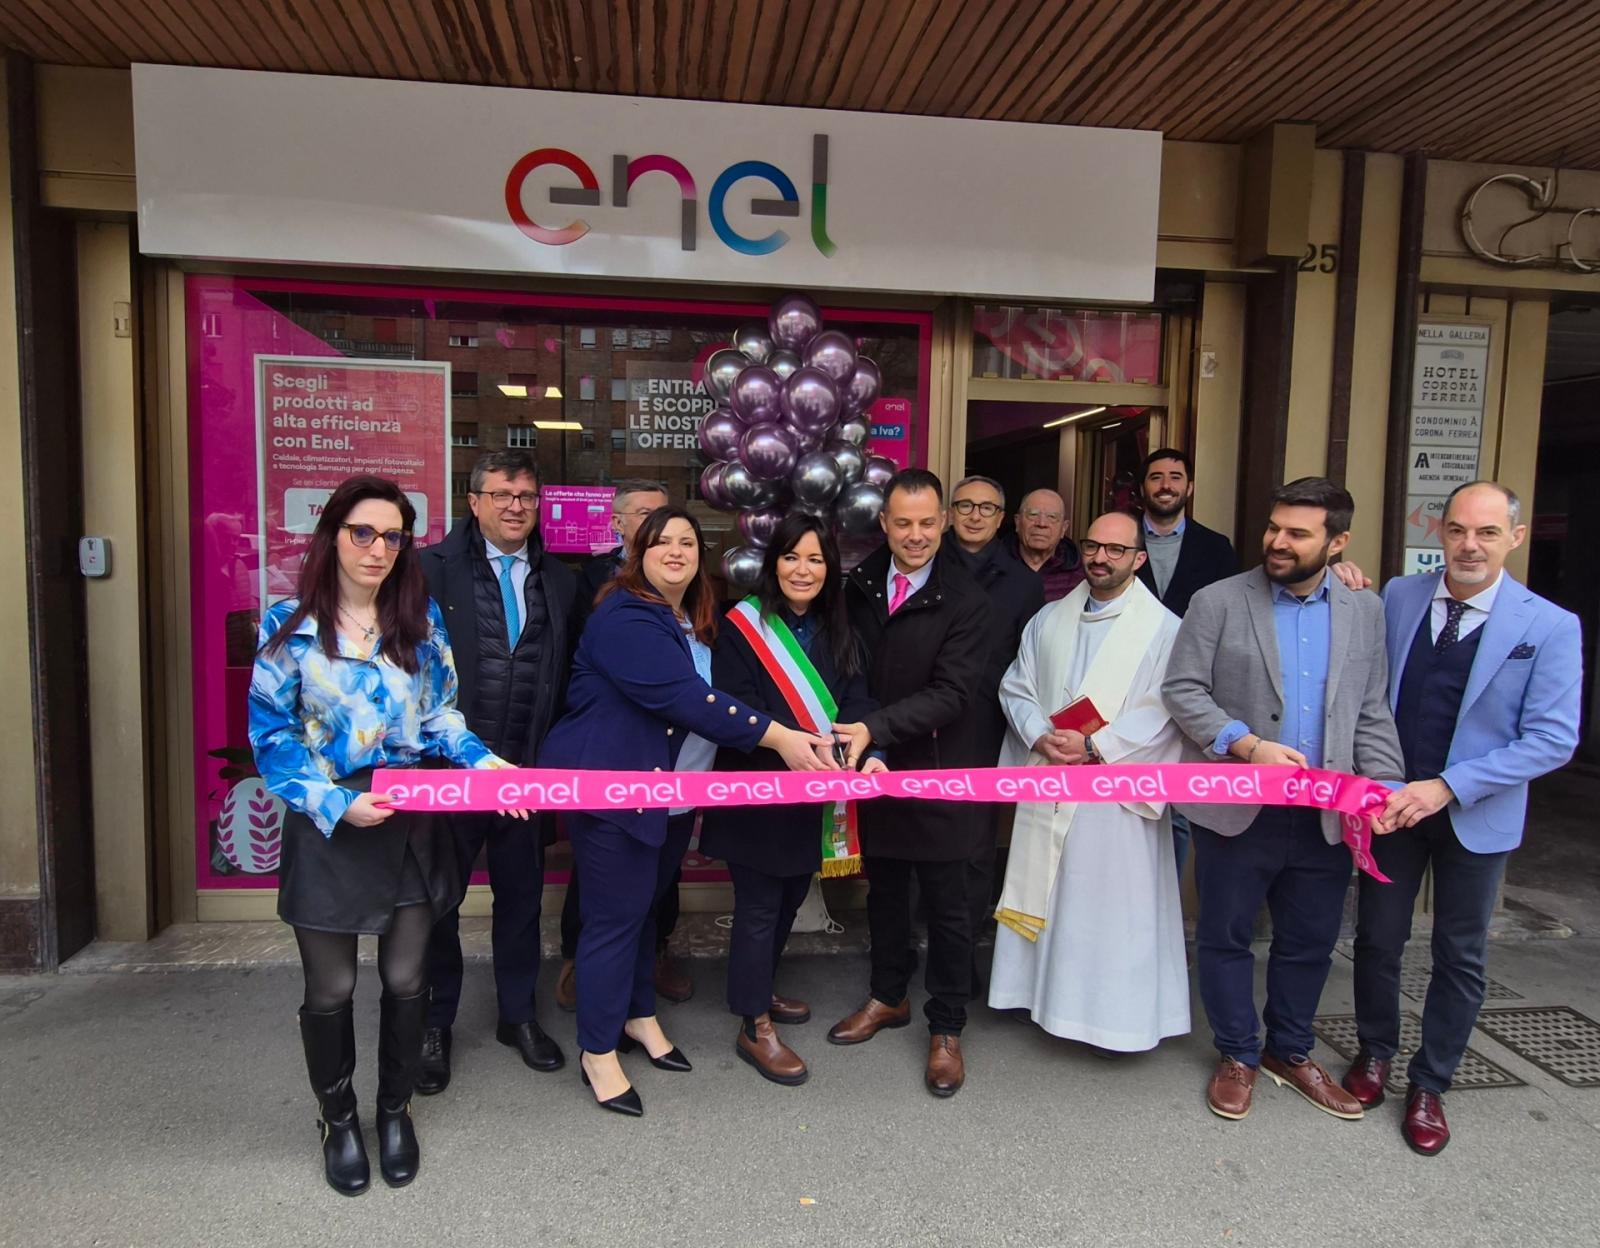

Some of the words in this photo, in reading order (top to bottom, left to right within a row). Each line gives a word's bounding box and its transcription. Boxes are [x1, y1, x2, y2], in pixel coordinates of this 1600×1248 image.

[505, 134, 838, 259] enel
[1298, 244, 1338, 273] 25
[1418, 329, 1443, 338] NELLA
[1449, 331, 1486, 341] GALLERIA
[1424, 366, 1479, 380] HOTEL
[272, 373, 328, 392] Scegli
[648, 378, 706, 395] ENTRA
[1422, 380, 1478, 392] CORONA
[272, 394, 348, 413] prodotti
[352, 398, 374, 412] ad
[639, 396, 650, 412] E
[1421, 392, 1477, 404] FERREA
[885, 403, 905, 411] enel
[272, 413, 308, 429] alta
[311, 415, 402, 434] efficienza
[629, 414, 650, 429] LE
[654, 415, 701, 431] NOST
[1415, 415, 1467, 427] CONDOMINIO
[880, 425, 901, 436] Iva?
[1414, 428, 1444, 437] CORONA
[1448, 429, 1479, 439] FERREA
[272, 435, 307, 449] con
[311, 433, 355, 451] Enel.
[637, 433, 701, 449] OFFERT
[303, 454, 352, 464] climatizzatori,
[354, 456, 384, 465] impianti
[385, 457, 425, 466] fotovoltaici
[279, 462, 317, 471] tecnologia
[318, 464, 350, 473] Samsung
[365, 466, 381, 474] ogni
[382, 467, 416, 475] esigenza.
[389, 776, 471, 807] enel
[497, 776, 580, 805] enel
[604, 776, 684, 804] enel
[706, 776, 784, 801] enel
[805, 772, 881, 798] enel
[901, 774, 976, 798] enel
[996, 771, 1072, 798] enel
[1092, 770, 1167, 798] enel
[1188, 770, 1263, 798] enel
[1283, 777, 1342, 803] enel
